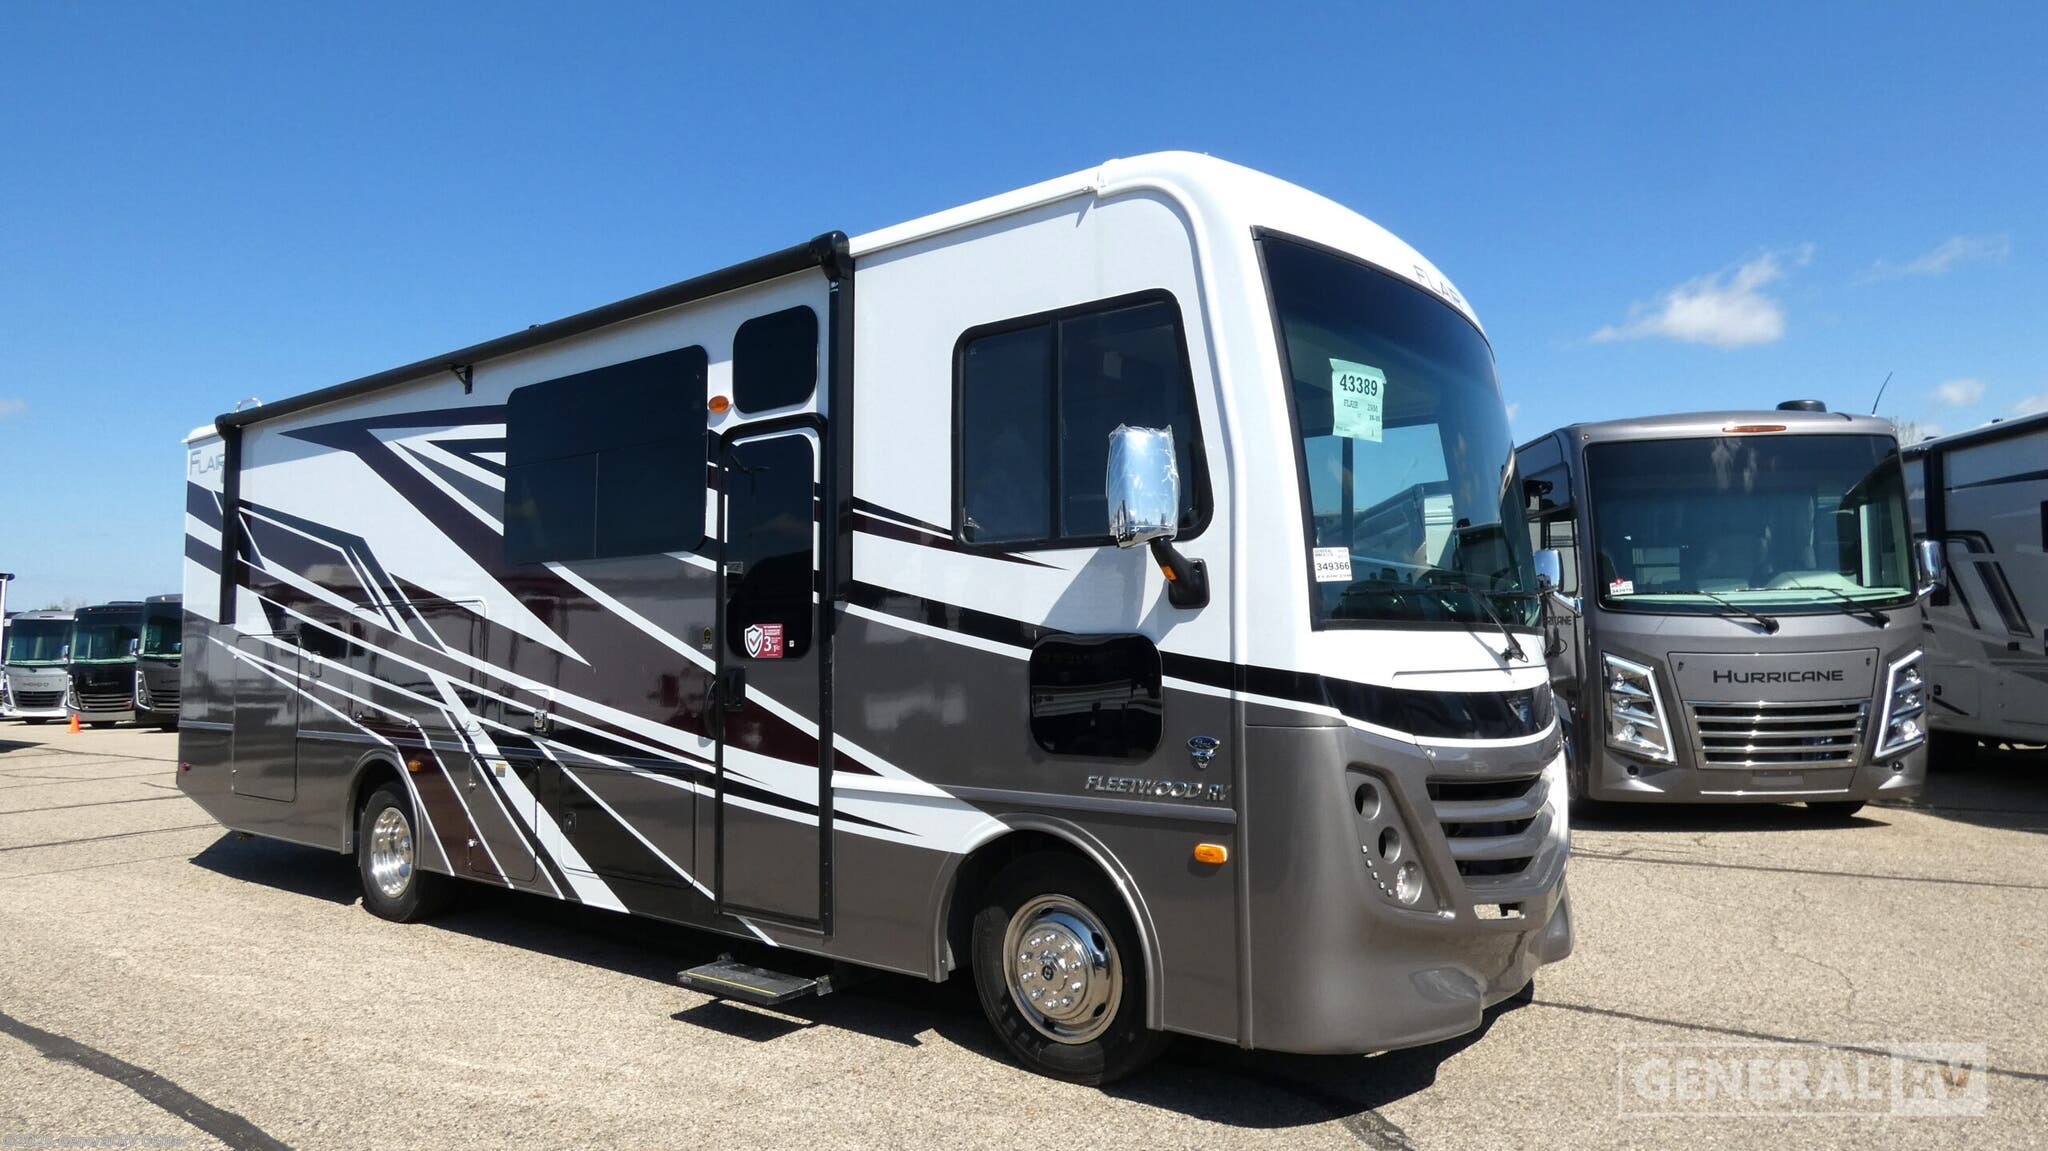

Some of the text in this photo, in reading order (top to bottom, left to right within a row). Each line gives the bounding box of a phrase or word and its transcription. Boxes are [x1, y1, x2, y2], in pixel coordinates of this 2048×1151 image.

[1340, 374, 1378, 396] 43389
[1316, 562, 1350, 571] 349366
[764, 636, 771, 652] 3
[1713, 670, 1844, 683] HURRICANE
[1085, 775, 1202, 799] FLEETWOOD
